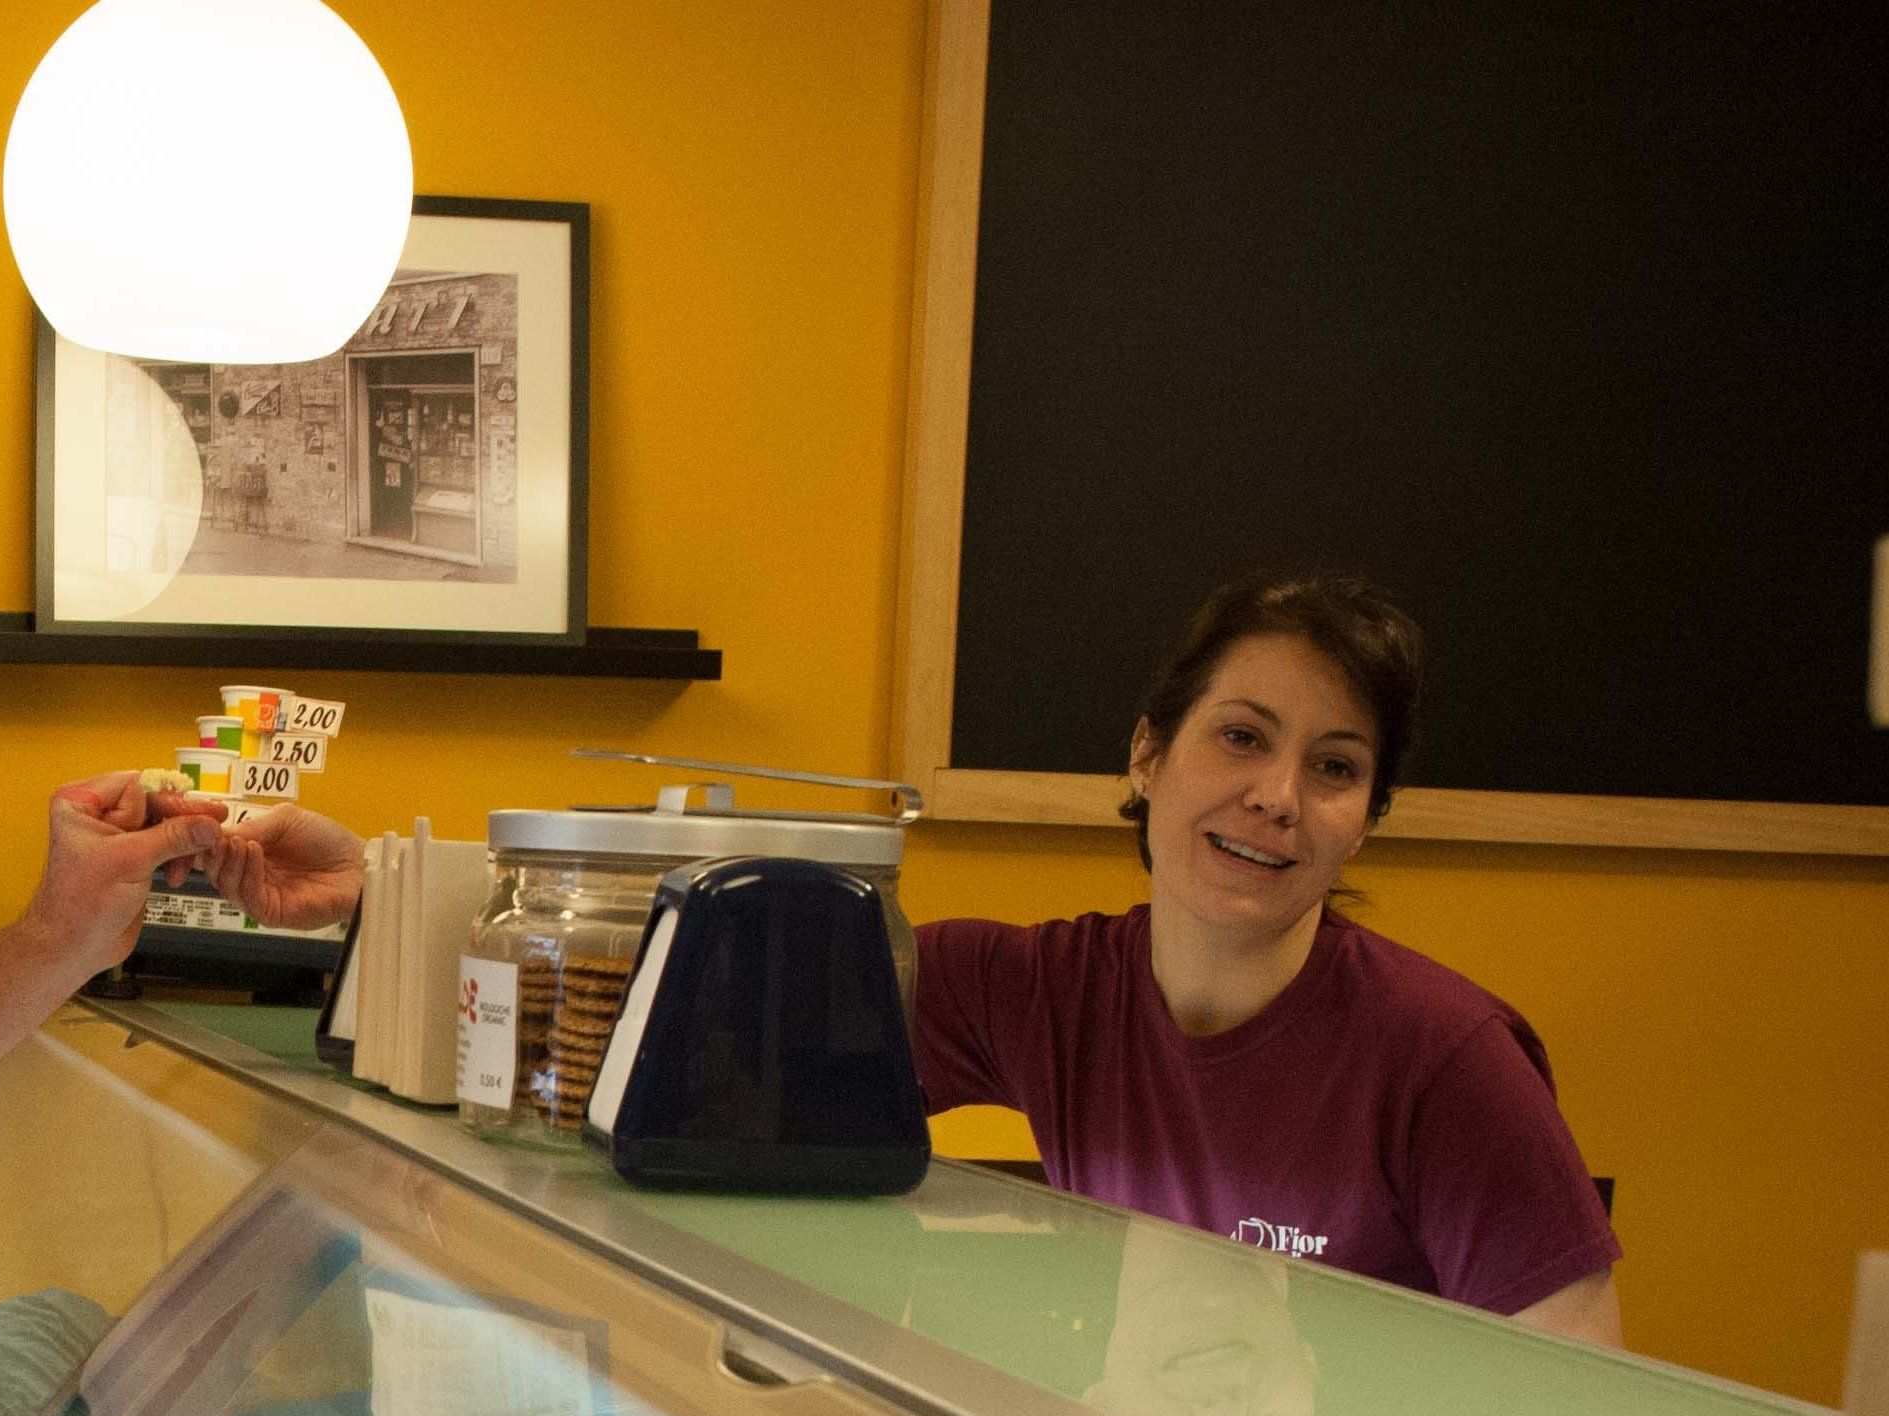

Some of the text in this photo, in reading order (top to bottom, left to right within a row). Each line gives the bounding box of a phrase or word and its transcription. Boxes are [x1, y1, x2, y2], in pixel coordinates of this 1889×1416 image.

[293, 703, 337, 729] 2,00
[244, 766, 290, 793] 3,00
[1276, 1224, 1329, 1256] Fior
